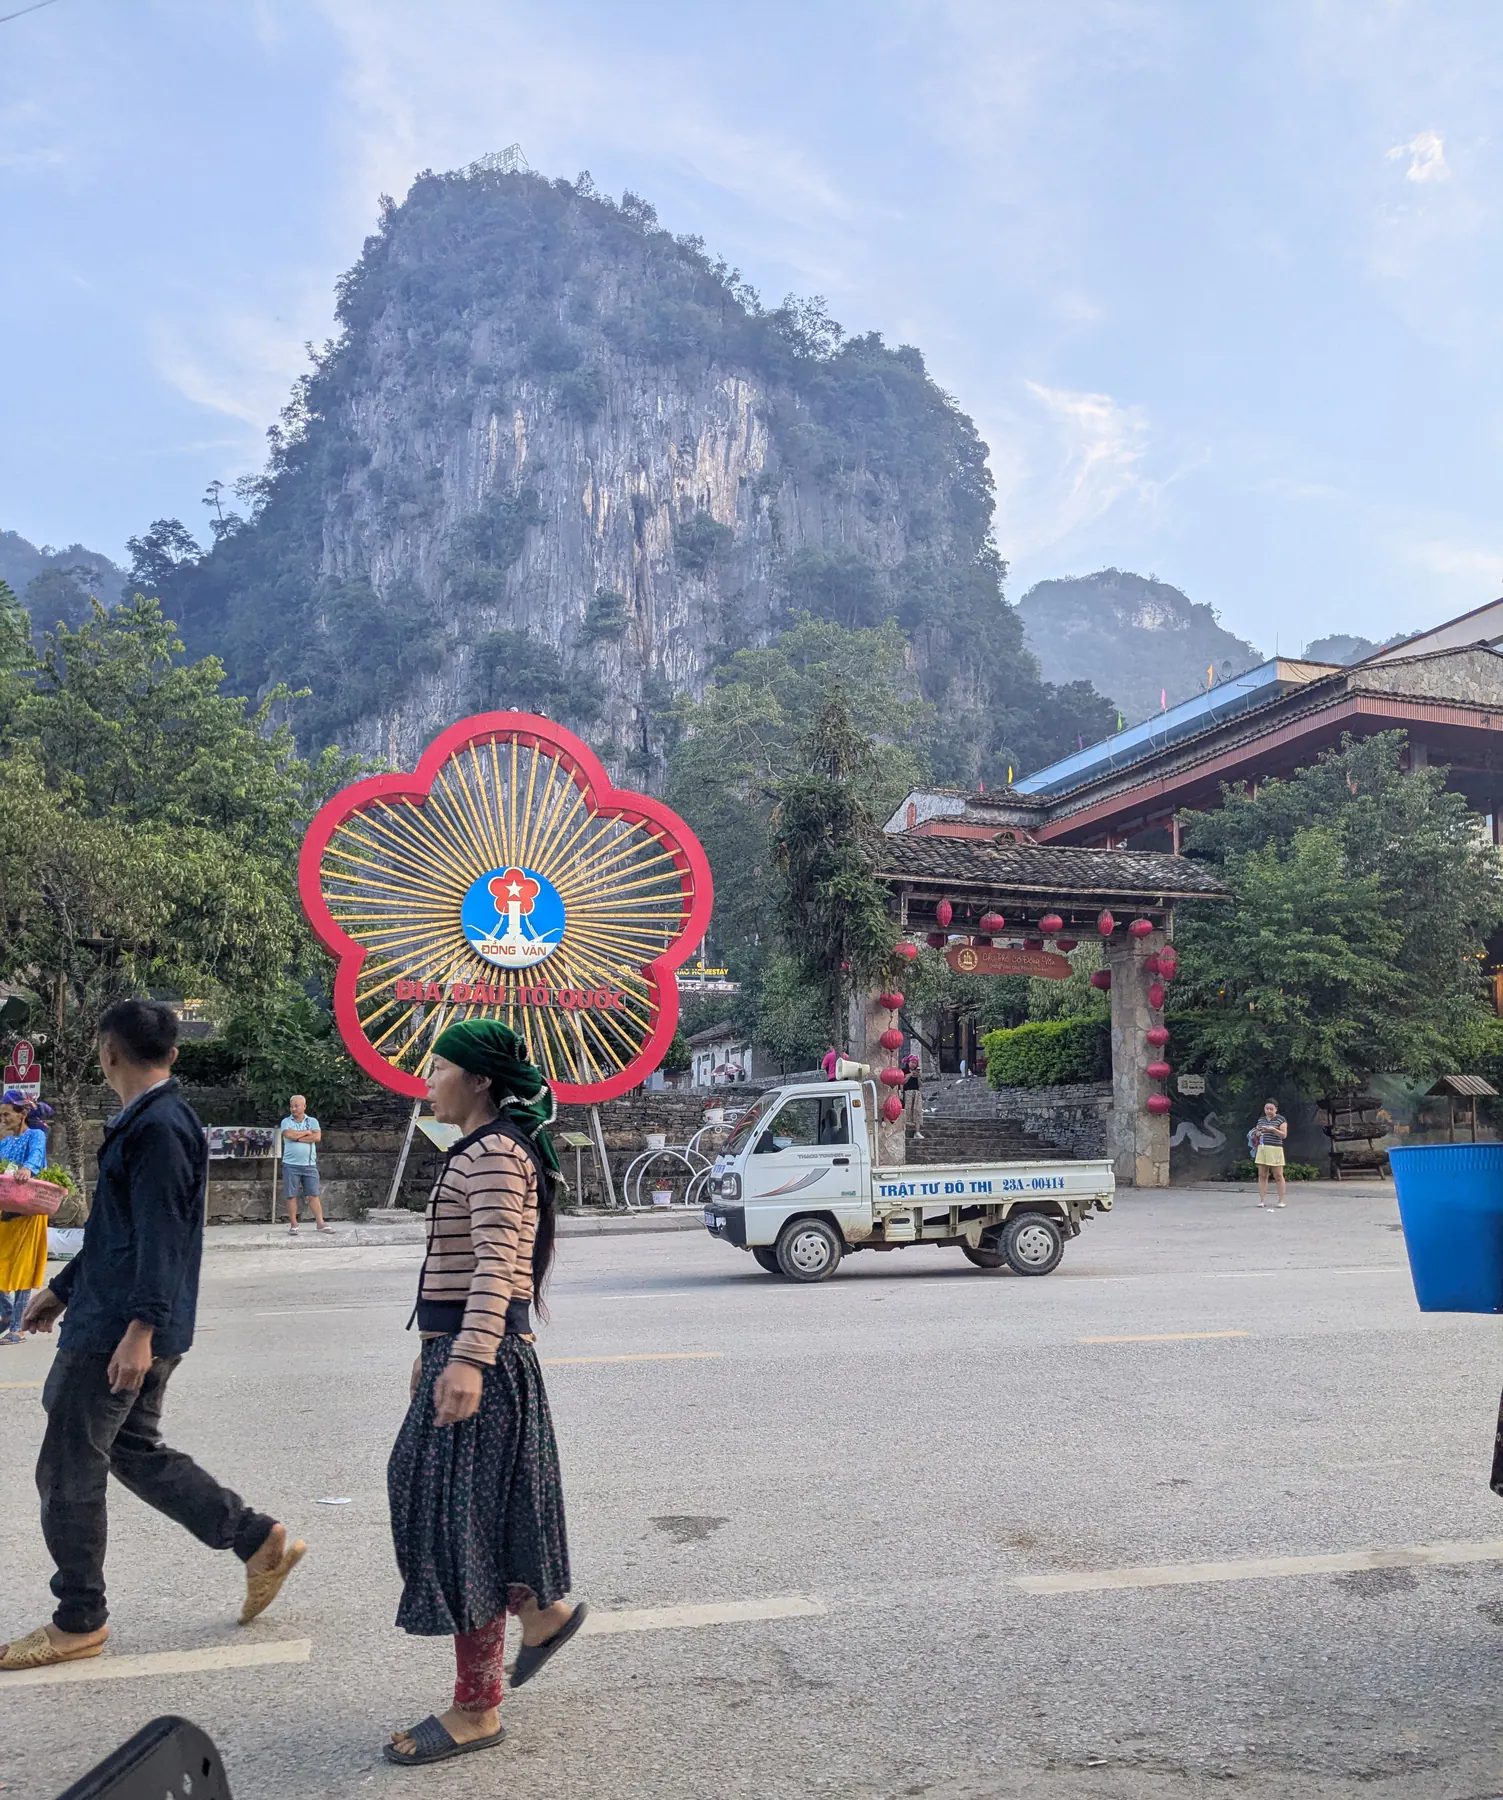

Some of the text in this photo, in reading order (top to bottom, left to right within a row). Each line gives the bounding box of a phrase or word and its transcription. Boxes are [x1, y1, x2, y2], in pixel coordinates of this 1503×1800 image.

[521, 944, 547, 956] VĂN
[395, 976, 627, 1011] ĐỊA ĐẦU TỔ QUỐC
[879, 1182, 916, 1198] TRẬT
[920, 1181, 940, 1196] TƯ
[944, 1179, 965, 1194] ĐÔ
[969, 1180, 992, 1194] THỊ
